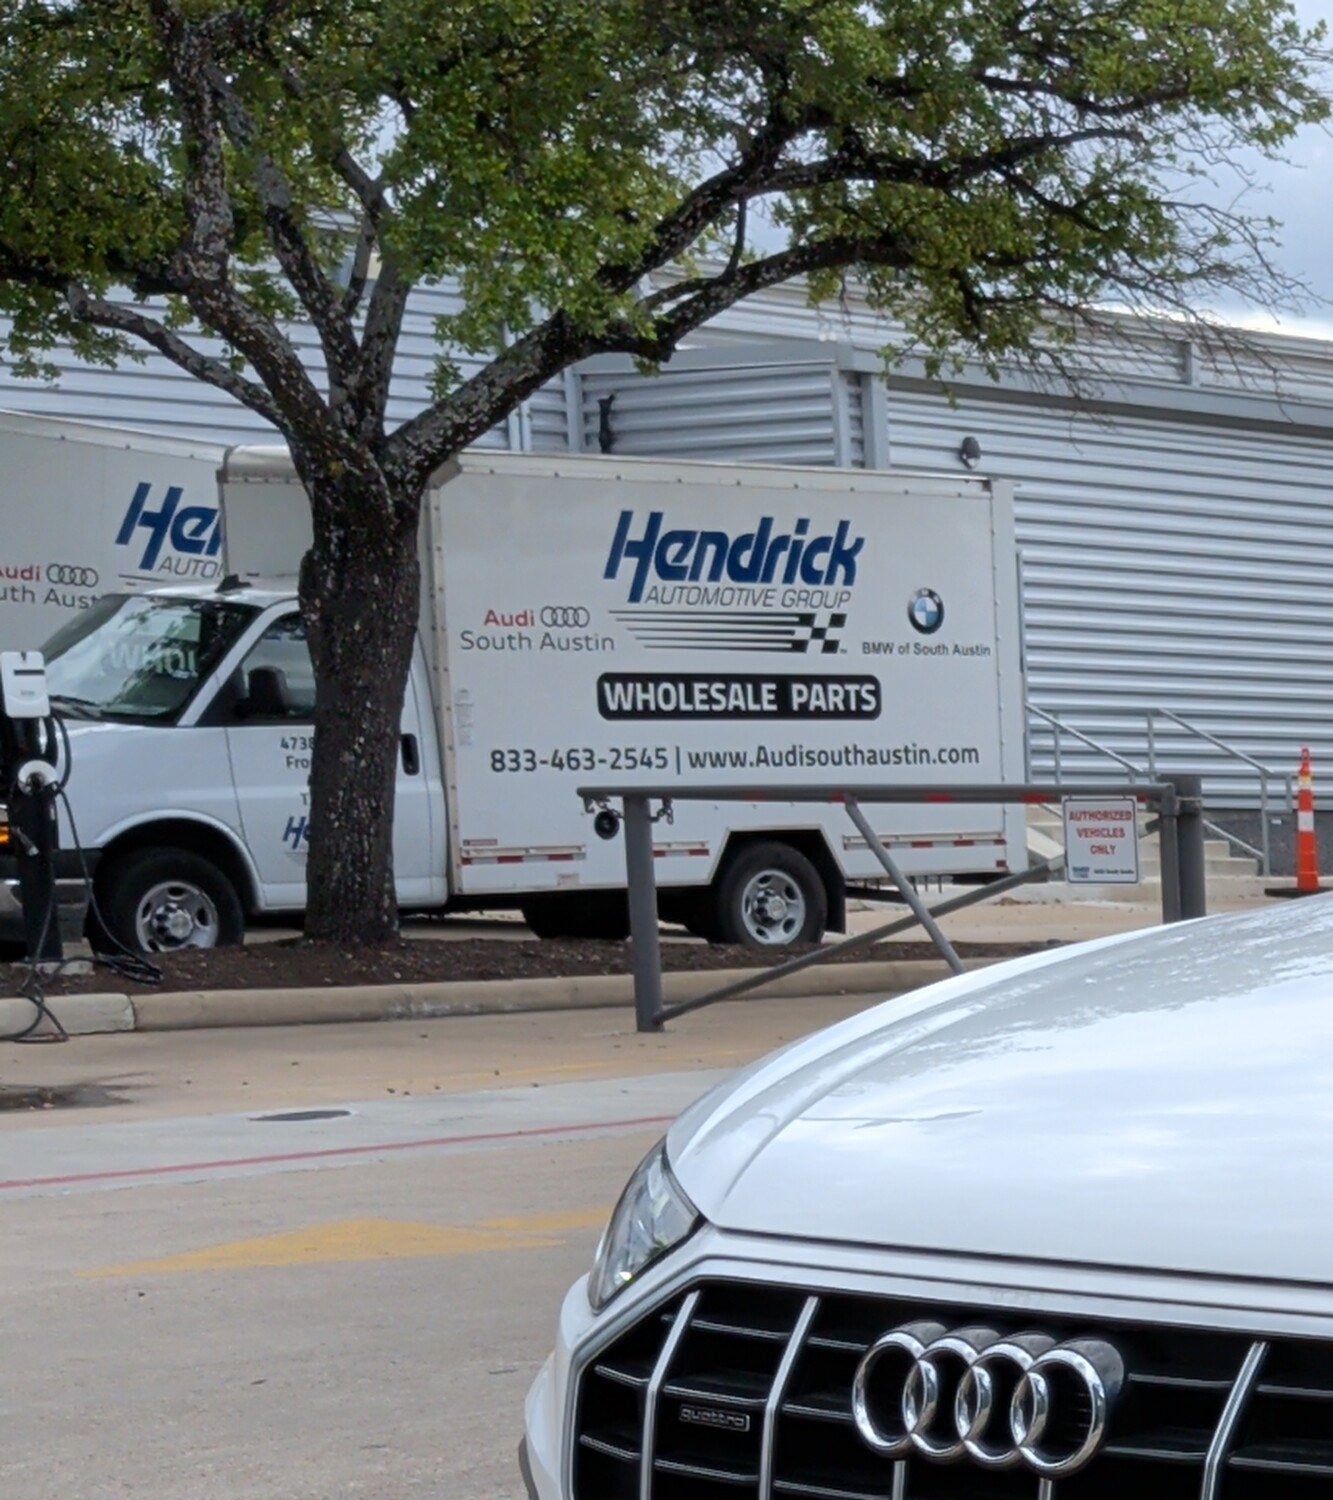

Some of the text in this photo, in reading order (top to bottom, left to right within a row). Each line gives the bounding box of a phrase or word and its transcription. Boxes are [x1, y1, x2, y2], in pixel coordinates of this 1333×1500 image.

[603, 510, 864, 603] Hendrick
[0, 565, 40, 582] udi
[0, 585, 101, 610] uth Aust
[646, 586, 851, 609] AUTOMOTIVE GROUP
[484, 609, 535, 627] Audi
[460, 630, 615, 651] South Austin
[862, 642, 895, 655] BMW
[898, 642, 910, 655] of
[913, 643, 949, 656] South
[952, 644, 991, 656] Austin
[603, 682, 876, 712] WHOLESALE PARTS
[490, 743, 980, 773] 833-463-2545 www.Audisouthaustin.com
[1069, 810, 1132, 821] AUTHORIZED
[1076, 827, 1125, 838] VEHICLES
[1090, 844, 1116, 855] ONLY
